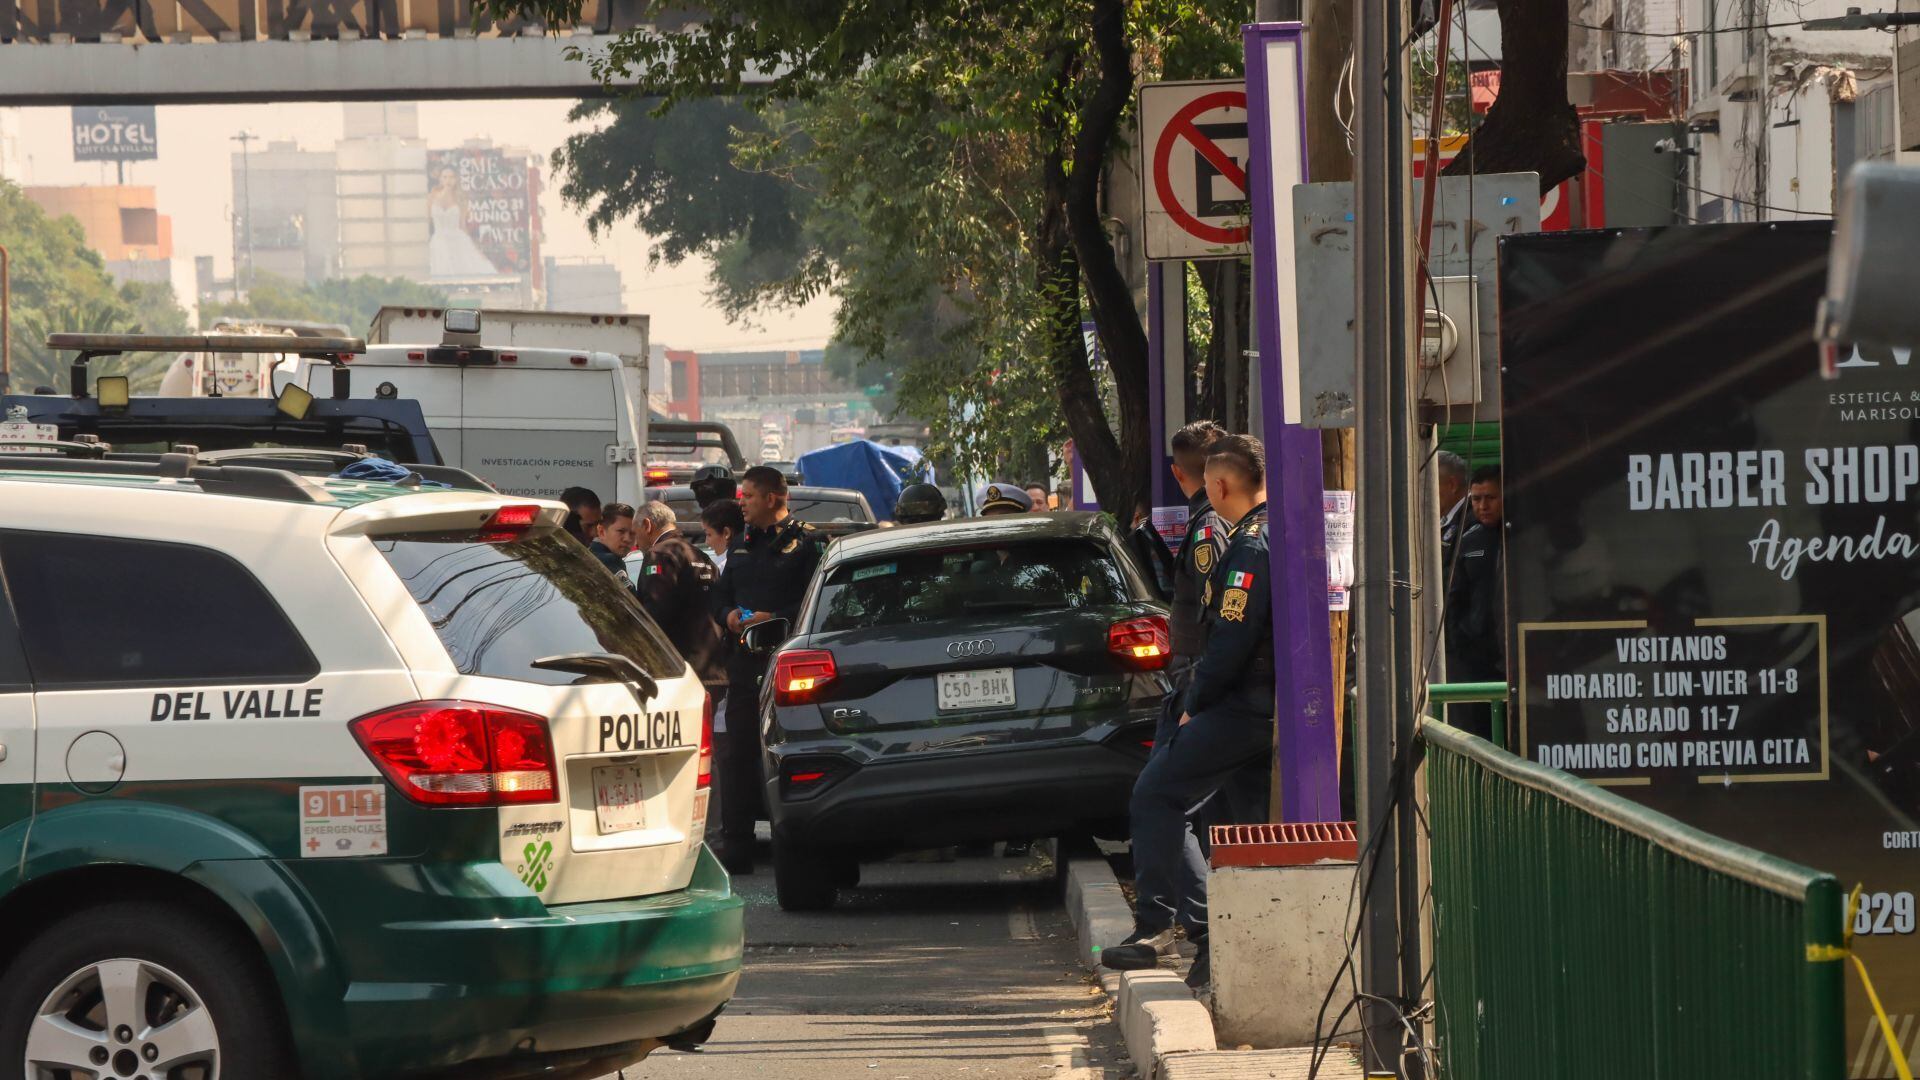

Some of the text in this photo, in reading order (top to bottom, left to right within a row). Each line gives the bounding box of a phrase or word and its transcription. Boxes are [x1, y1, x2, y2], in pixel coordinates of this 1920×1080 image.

[76, 124, 154, 144] HOTEL
[460, 159, 470, 191] EXPO
[470, 157, 499, 174] ME
[470, 173, 522, 191] CASO
[468, 199, 508, 210] MAYO
[467, 210, 511, 223] JUNIO
[491, 228, 525, 243] WTC
[1829, 392, 1902, 404] ESTETICA
[1841, 407, 1920, 421] MARISOL
[481, 458, 551, 466] INVESTIGACIÓN
[1628, 445, 1920, 510] BARBER SHOP
[1748, 515, 1920, 580] Agenda
[1616, 635, 1727, 663] VISITANOS
[943, 678, 1010, 699] C50-BHK
[1547, 668, 1799, 699] HORARIO: LUN-VIER 11-8
[150, 689, 323, 721] DEL VALLE
[1606, 704, 1740, 733] SÁBADO 11-7
[601, 711, 682, 752] POLICIA
[1538, 738, 1810, 769] DOMINGO CON PREVIA CITA
[309, 794, 374, 815] 911
[304, 824, 383, 835] EMERGENCIAS
[1883, 831, 1920, 849] CORT
[1843, 891, 1915, 935] 829
